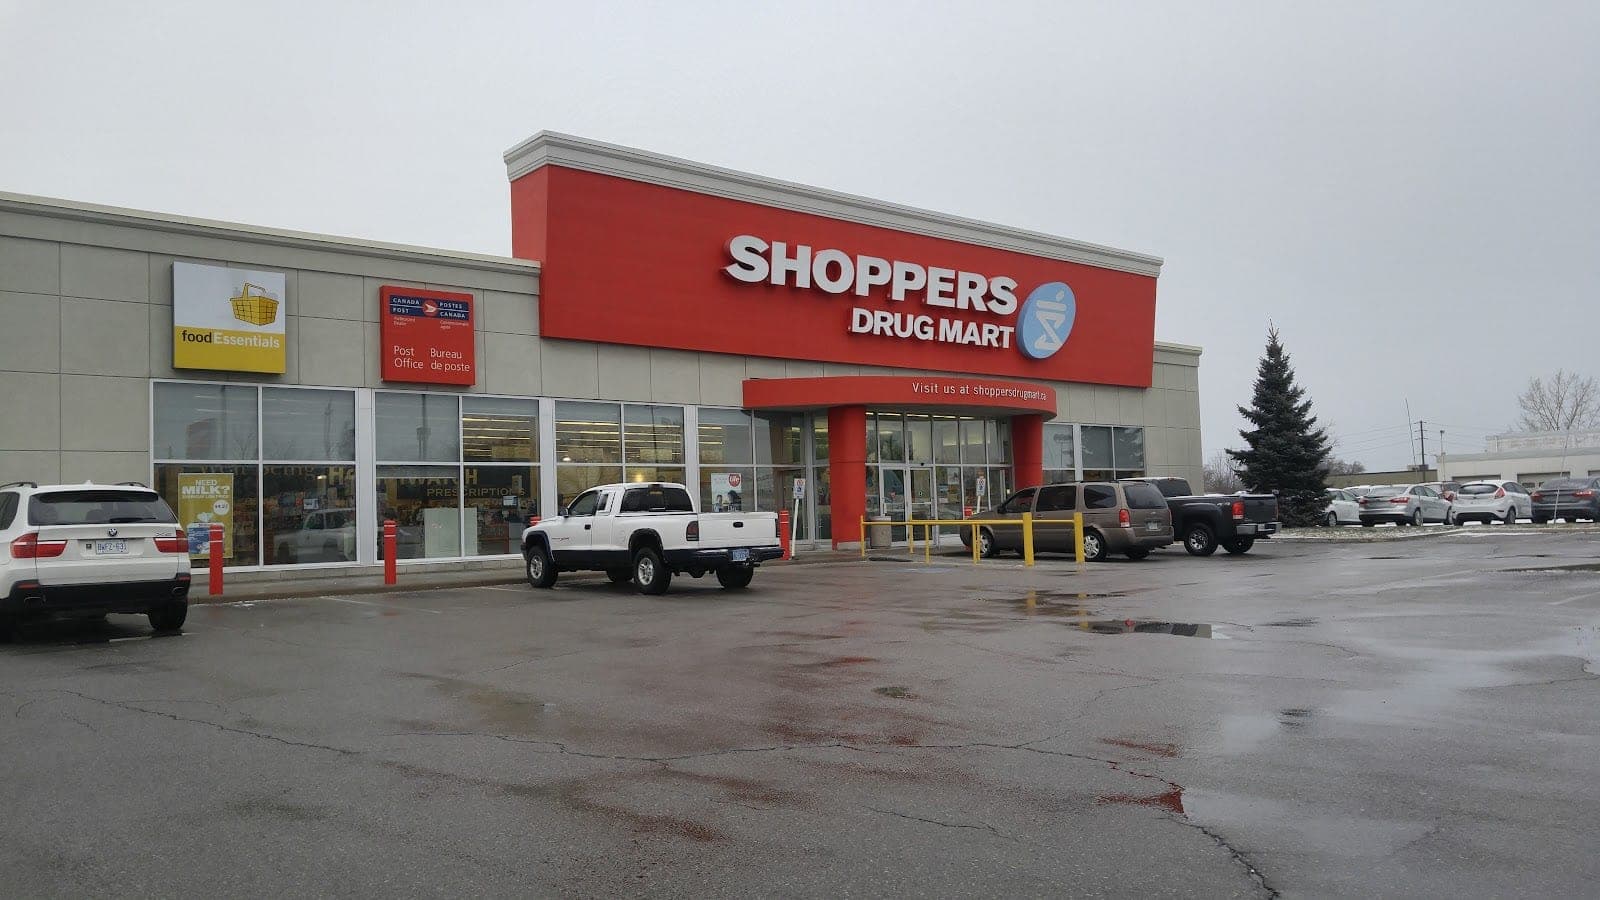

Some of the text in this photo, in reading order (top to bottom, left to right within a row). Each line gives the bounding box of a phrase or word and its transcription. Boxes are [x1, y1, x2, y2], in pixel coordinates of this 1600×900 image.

[723, 234, 1018, 315] SHOPPERS
[392, 297, 420, 305] CANADA
[439, 301, 463, 309] POSTES
[440, 311, 466, 319] CANADA
[851, 307, 1015, 349] DRUG MART
[393, 345, 415, 356] Post
[430, 347, 463, 359] Bureau
[394, 357, 424, 369] Office
[430, 360, 470, 372] de poste
[912, 382, 1047, 400] Visit us at shoppersdrugmart.ca
[181, 485, 231, 495] MILK?
